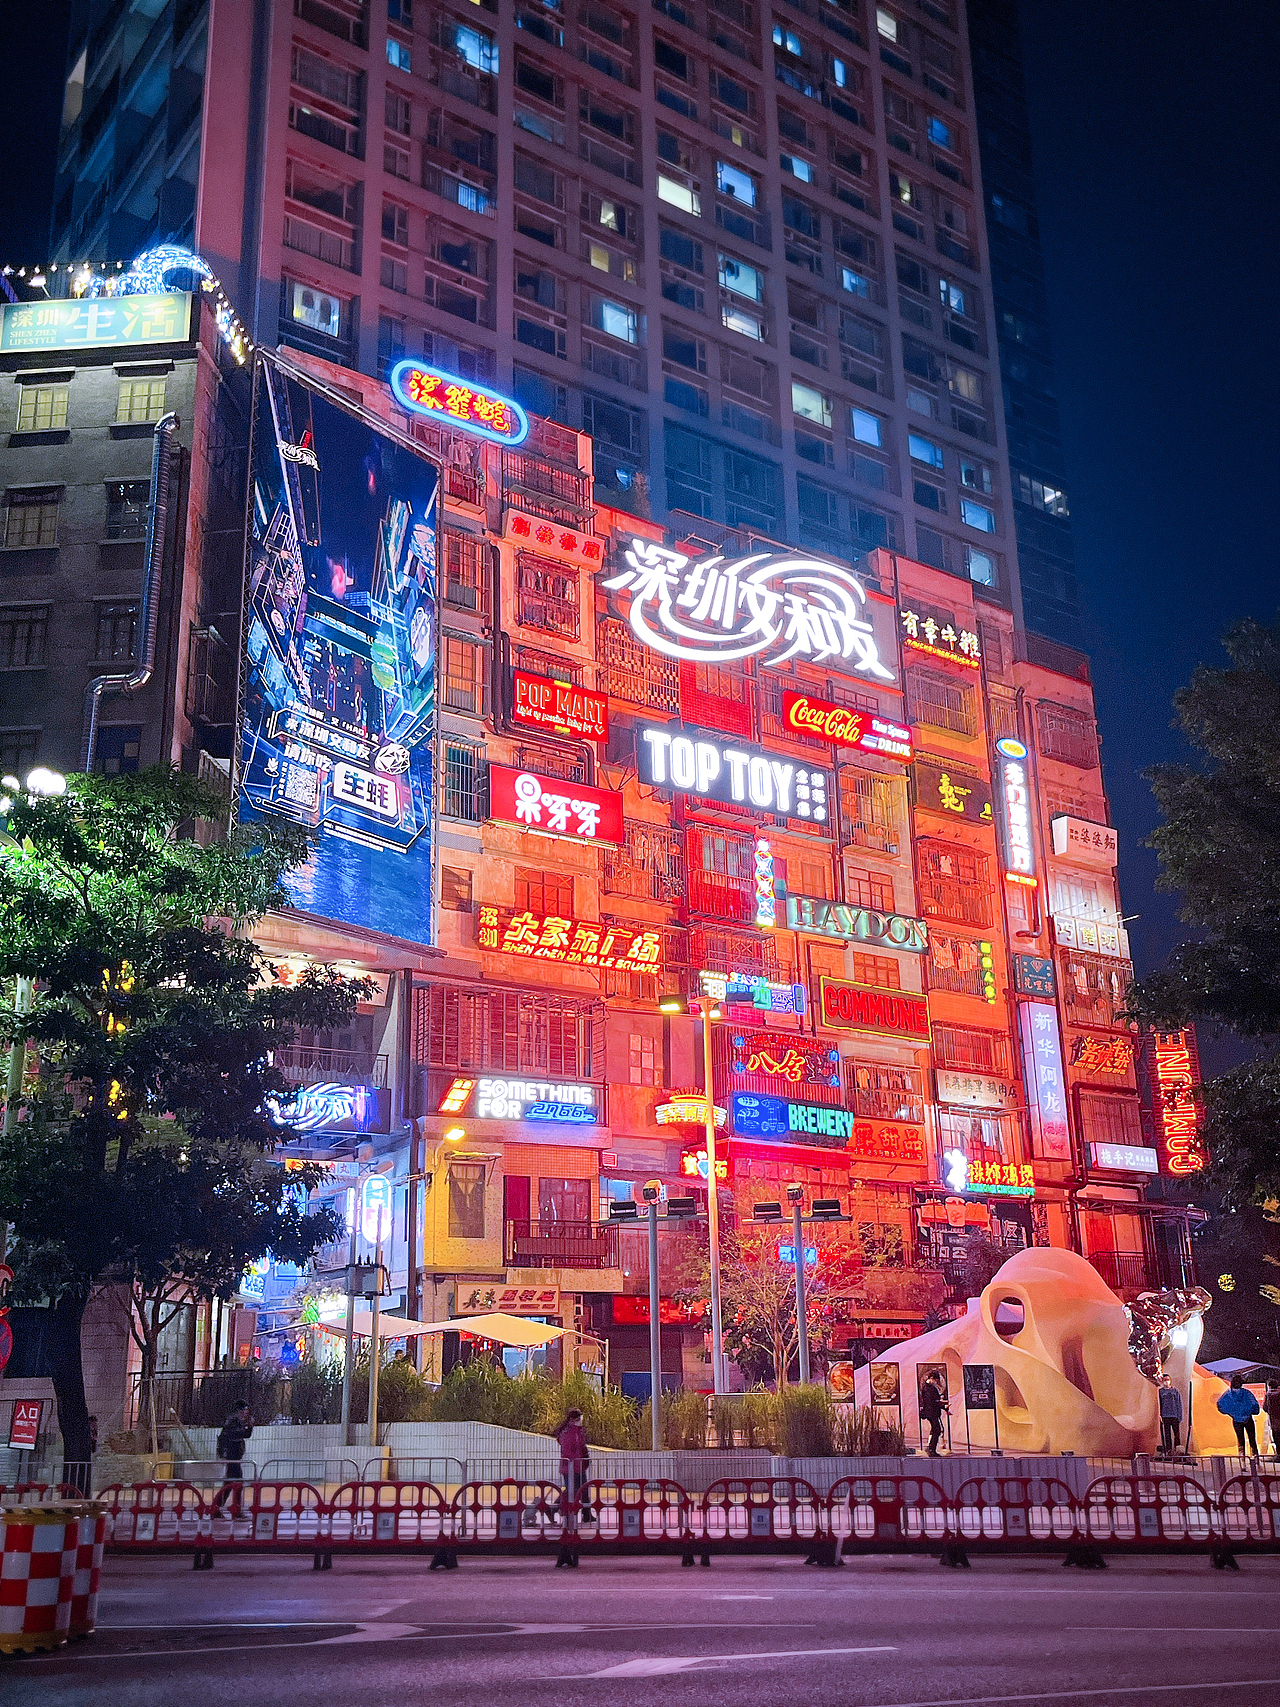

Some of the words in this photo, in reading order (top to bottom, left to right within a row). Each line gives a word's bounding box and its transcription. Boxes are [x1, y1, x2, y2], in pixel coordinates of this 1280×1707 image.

[11, 309, 58, 328] 深圳
[64, 298, 178, 342] 生活
[9, 337, 56, 346] LIFESTYLE
[10, 330, 32, 338] SHEN
[34, 329, 57, 337] ZHEN
[516, 678, 553, 710] POP
[556, 689, 606, 725] MART
[877, 737, 911, 757] DRINK
[642, 729, 720, 793] TOP
[722, 749, 794, 812] TOY
[478, 906, 499, 948] 深圳
[794, 896, 929, 948] HAYDON
[613, 958, 661, 974] SQUARE
[730, 971, 768, 987] SEASON
[824, 984, 930, 1033] COMMUNE
[478, 1079, 593, 1105] SOMETHING
[478, 1100, 522, 1119] FOR
[788, 1103, 854, 1138] BREWERY
[16, 1405, 38, 1419] 入口
